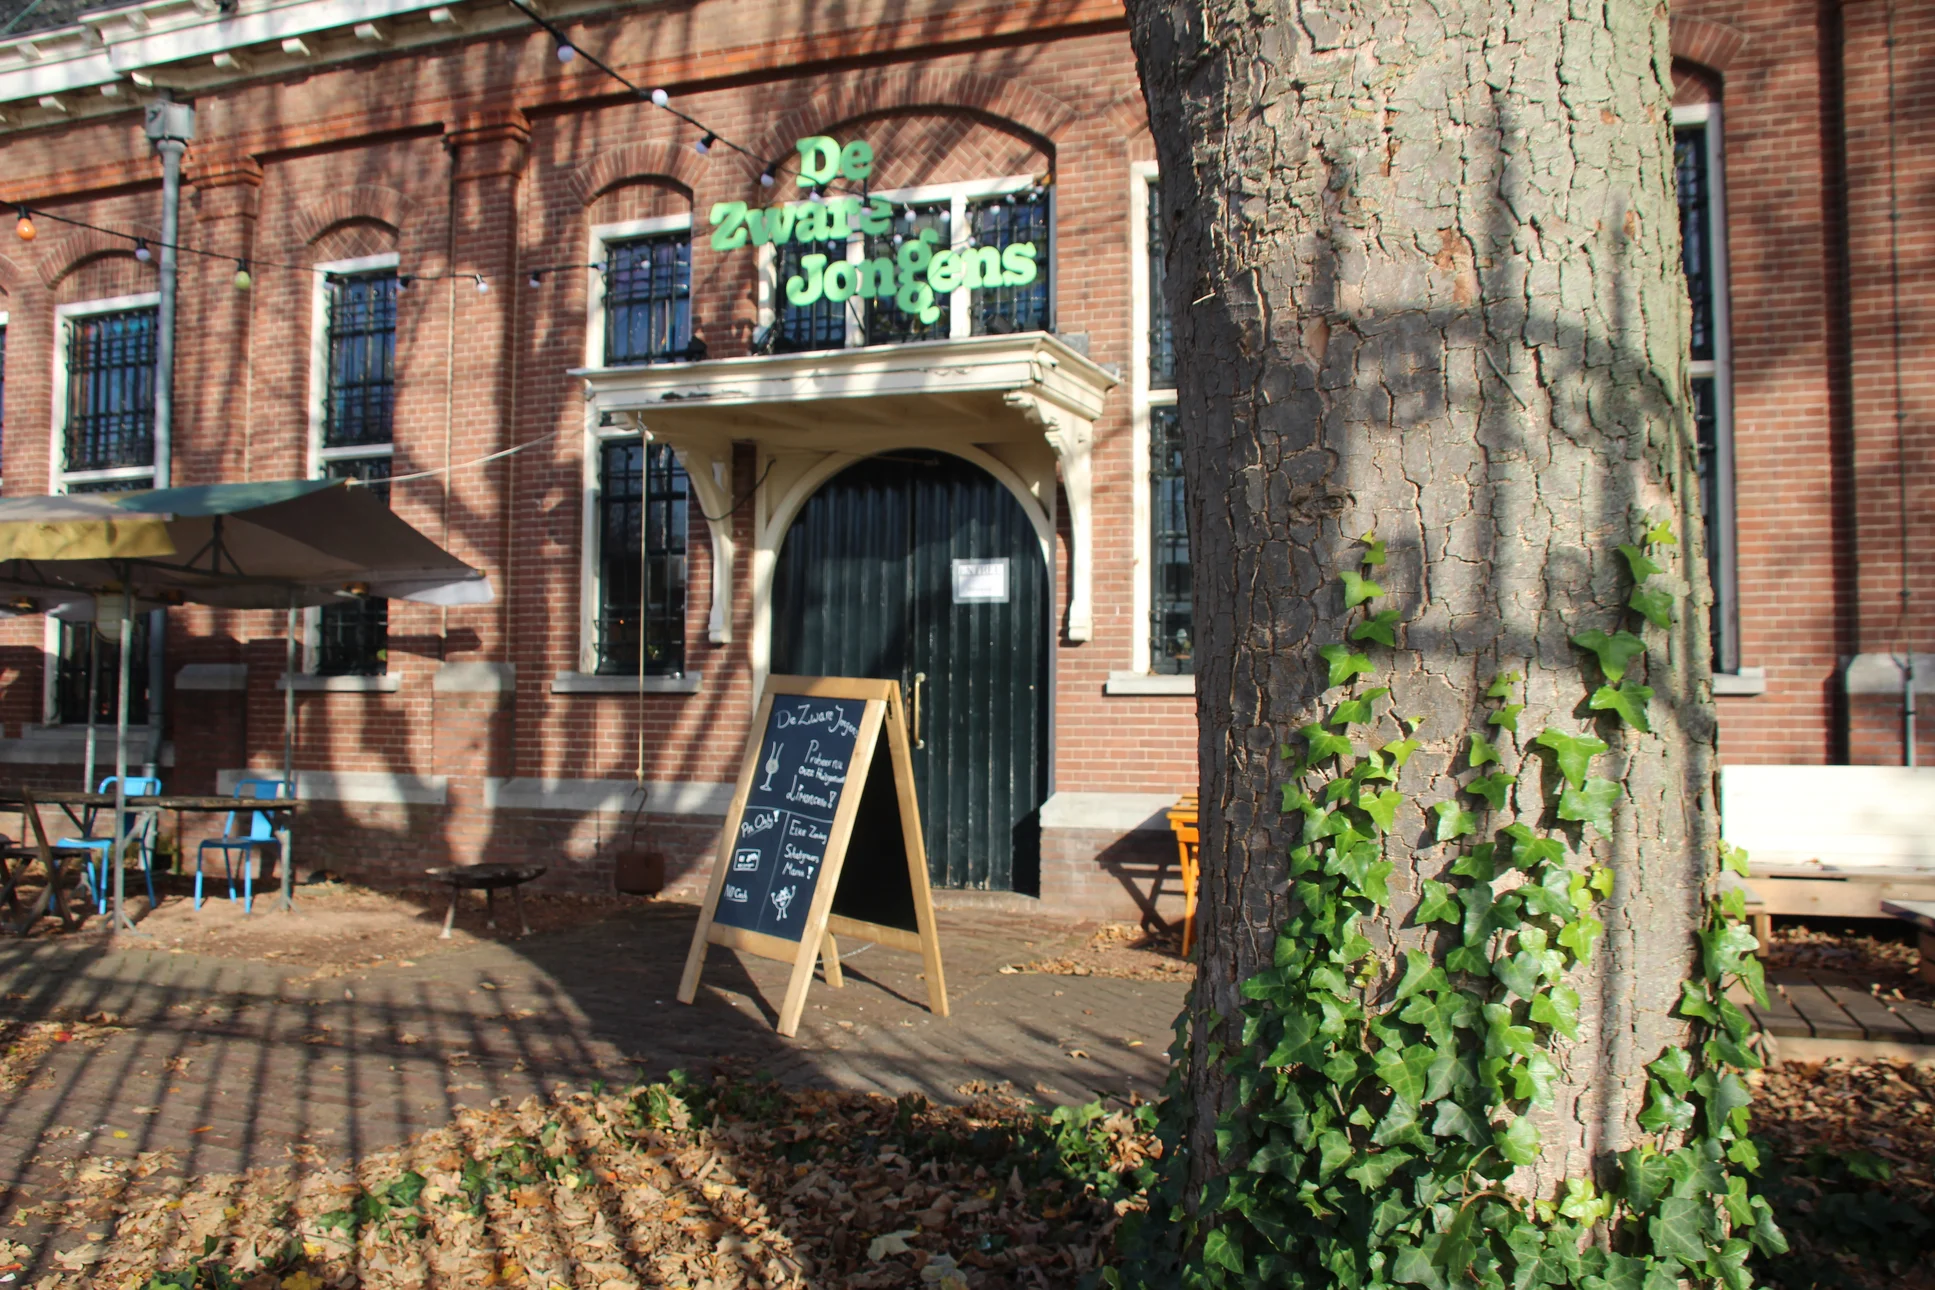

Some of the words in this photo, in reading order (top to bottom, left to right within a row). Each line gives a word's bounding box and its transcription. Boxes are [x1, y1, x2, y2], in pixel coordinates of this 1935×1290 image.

[796, 136, 874, 187] De
[710, 195, 892, 251] Zware
[786, 228, 1037, 324] Jongens
[775, 709, 797, 728] De
[797, 704, 834, 725] Zware
